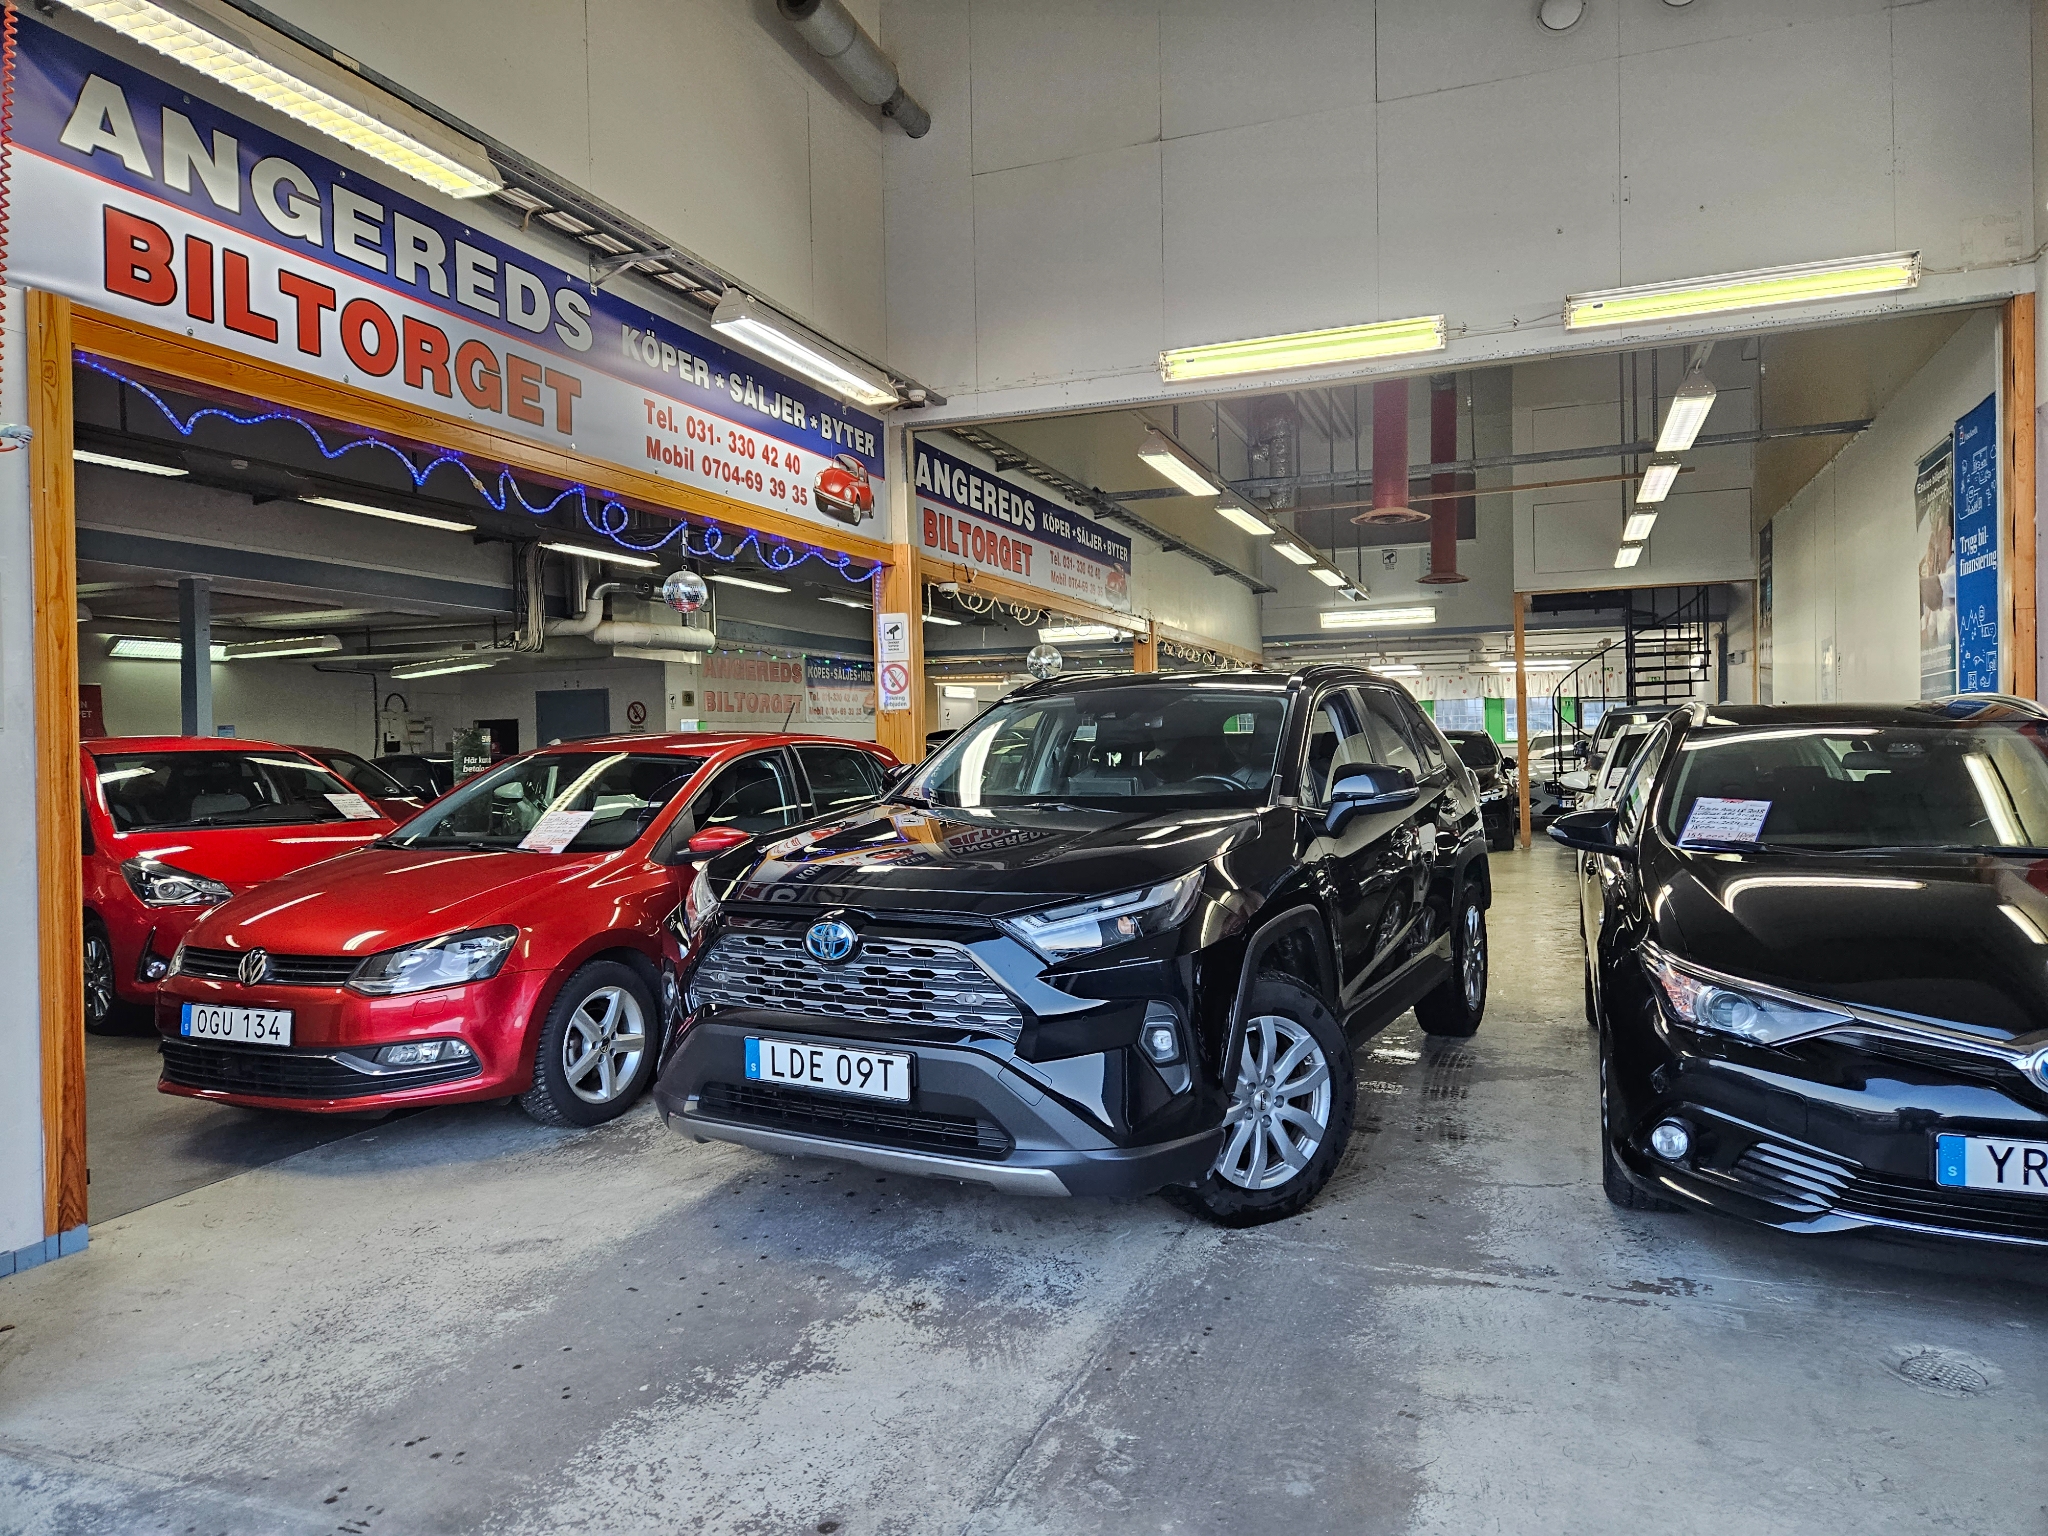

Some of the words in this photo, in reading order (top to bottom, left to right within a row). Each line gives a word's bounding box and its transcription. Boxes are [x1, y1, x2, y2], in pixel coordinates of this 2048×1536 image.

[58, 73, 593, 351] ANGEREDS
[103, 204, 581, 436] BILTORGET
[621, 324, 710, 389] KÖPER
[730, 374, 806, 429] SÄLJER
[820, 413, 875, 457] BYTER
[644, 398, 678, 433] Tel.
[686, 416, 721, 445] 031-
[728, 431, 755, 460] 330
[761, 444, 779, 468] 42
[784, 452, 801, 475] 40
[646, 436, 694, 472] Mobil
[701, 455, 763, 492] 0704-69
[769, 478, 786, 499] 39
[792, 485, 808, 506] 35
[915, 452, 1036, 532] ANGEREDS
[923, 508, 1033, 576] BILTORGET
[1042, 512, 1071, 540] KÖPER
[1076, 527, 1103, 552] SÄLJER
[1107, 539, 1128, 562] BYTER
[1960, 536, 1978, 556] Trygg
[1050, 550, 1061, 566] Tel.
[1960, 549, 1997, 577] finansiering
[1051, 570, 1066, 586] Mobil
[703, 656, 803, 683] ANGEREDS
[703, 690, 803, 714] BILTORGET
[463, 756, 477, 764] Här
[198, 1009, 232, 1035] OGU
[243, 1014, 280, 1040] 134
[750, 1063, 757, 1071] S
[771, 1046, 823, 1082] LDE
[837, 1054, 894, 1092] 09T
[1947, 1166, 1958, 1176] S
[1986, 1145, 2048, 1187] YR
